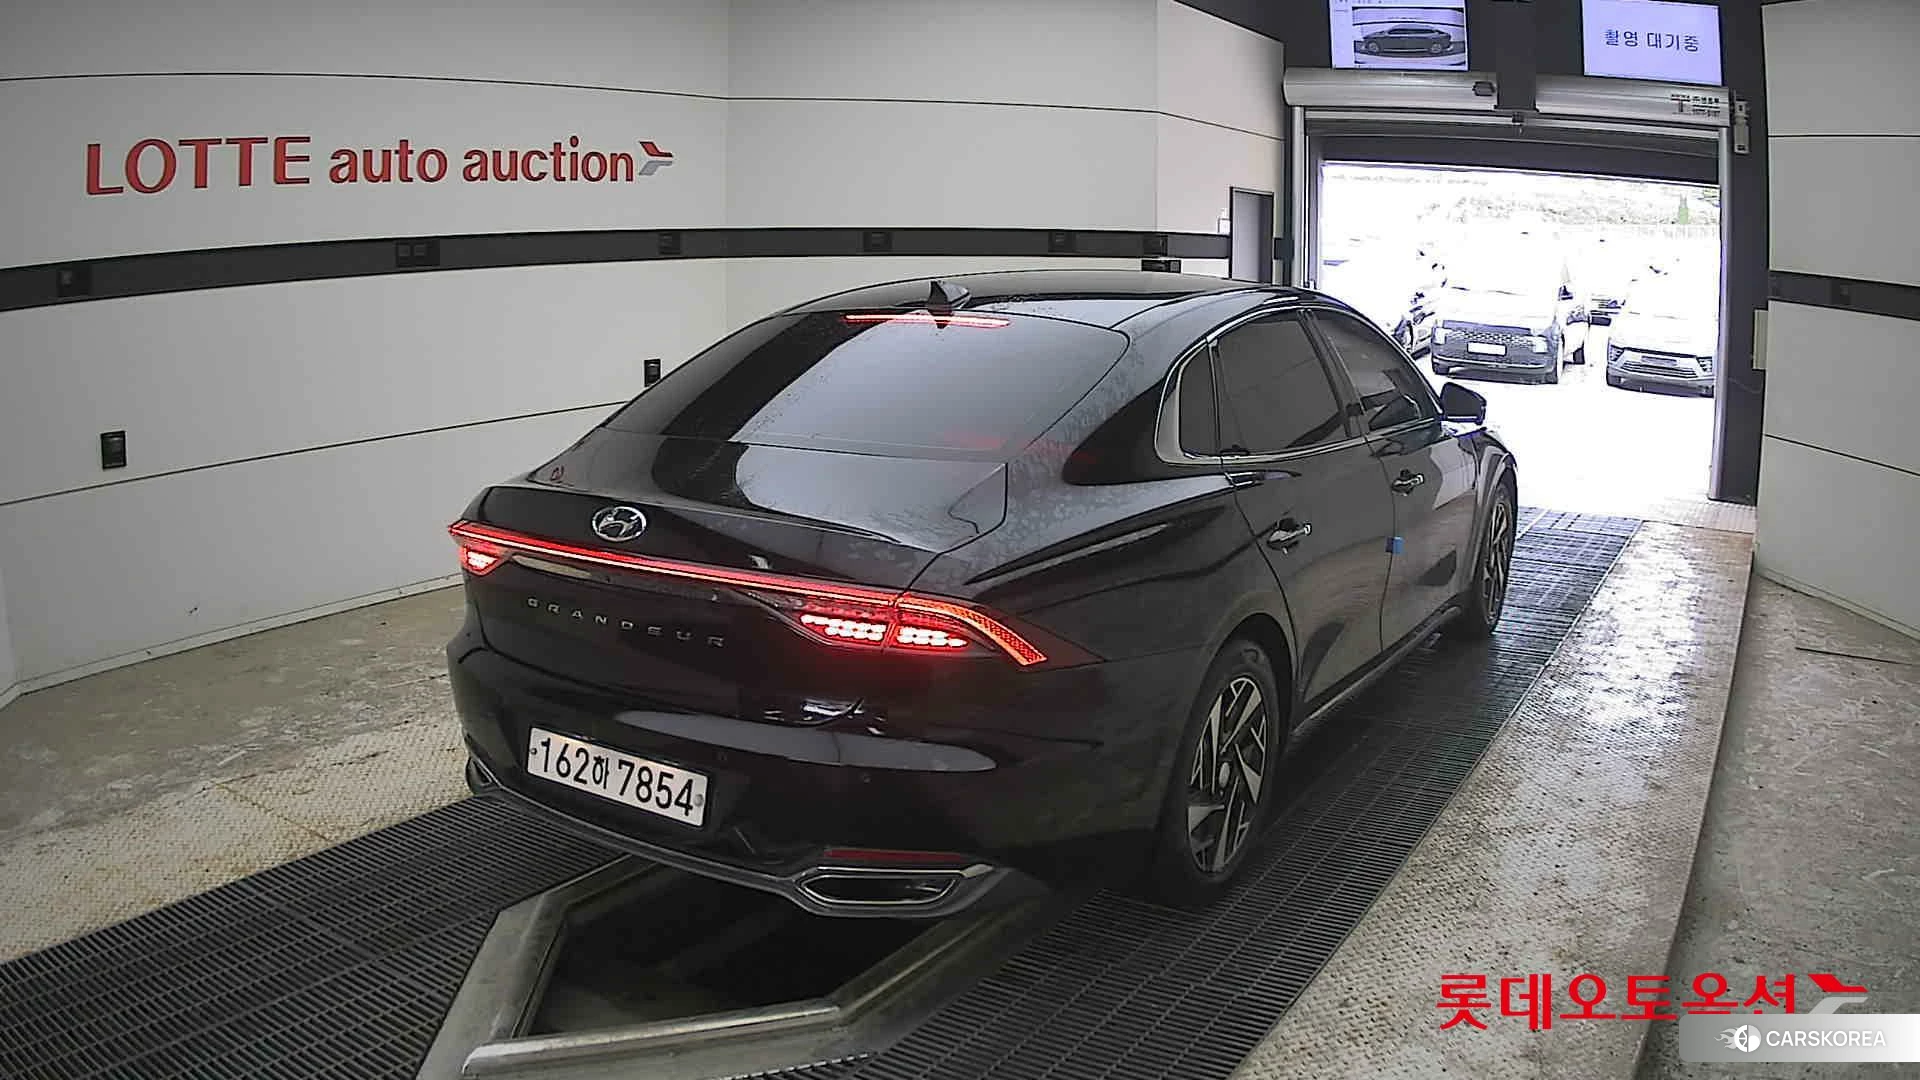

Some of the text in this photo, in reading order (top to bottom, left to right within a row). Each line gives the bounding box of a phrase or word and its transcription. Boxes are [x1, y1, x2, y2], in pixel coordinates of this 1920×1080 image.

[1604, 28, 1699, 53] 촬영 대기중
[85, 135, 635, 196] LOTTE auto auction
[526, 596, 725, 648] GRANDEUR
[540, 736, 694, 817] 162하 7854
